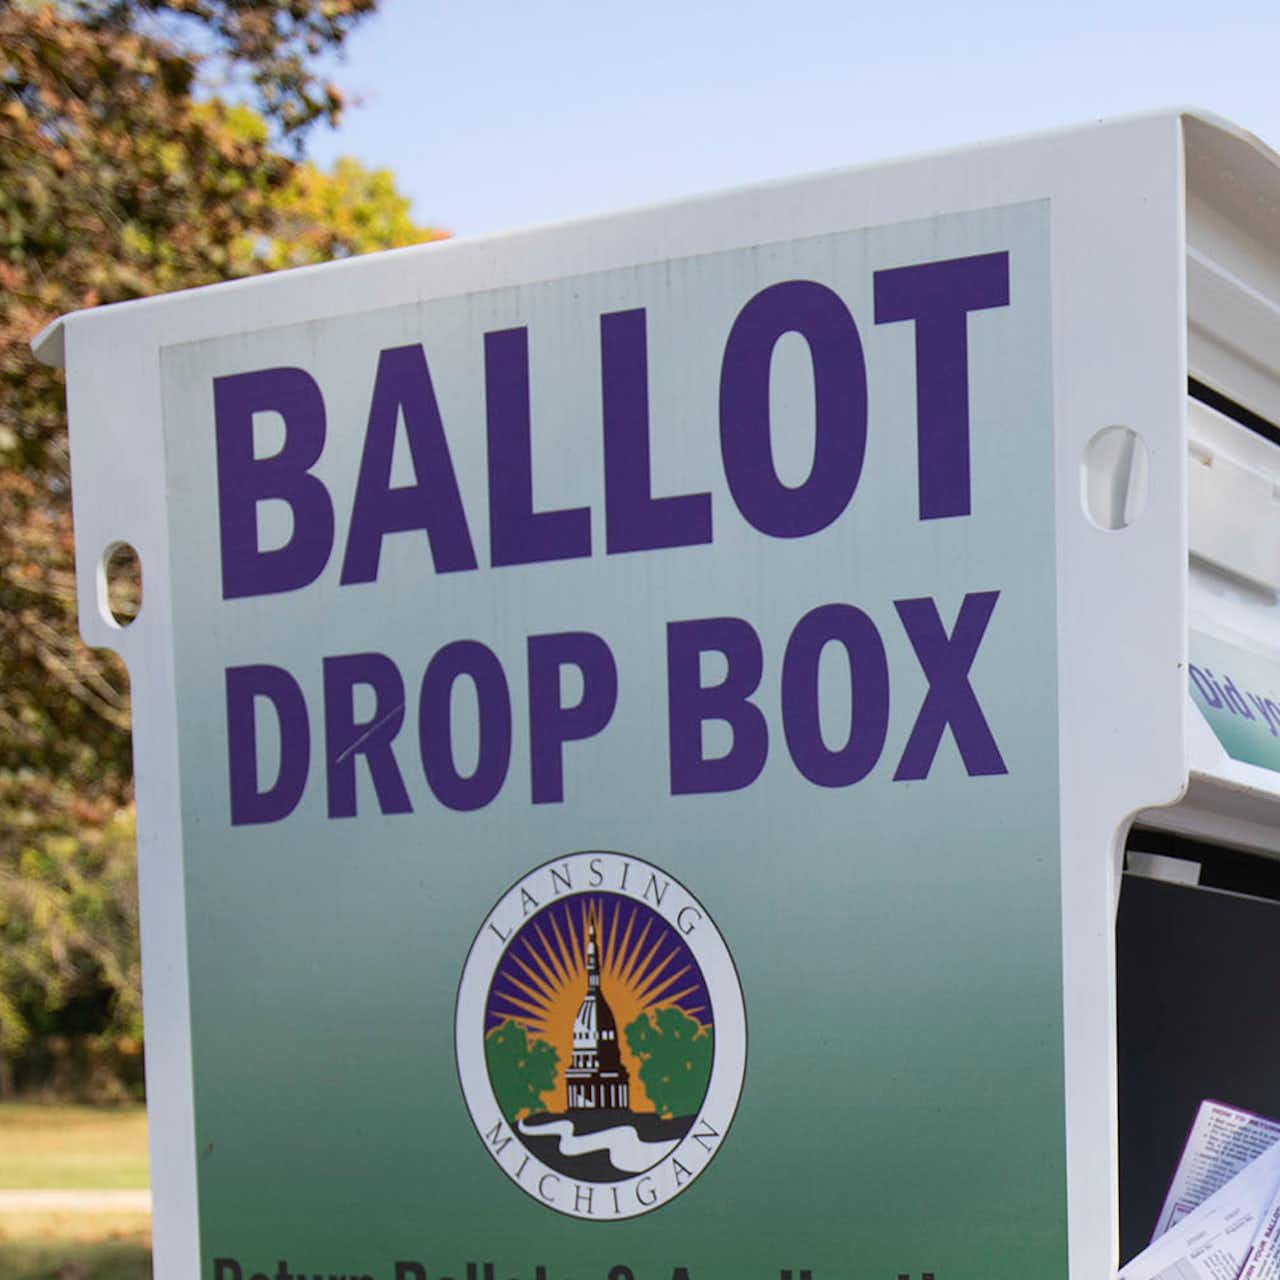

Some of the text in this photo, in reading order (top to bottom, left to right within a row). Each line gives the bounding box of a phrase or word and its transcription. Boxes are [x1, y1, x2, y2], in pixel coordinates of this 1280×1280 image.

[212, 250, 1010, 600] BALLOT
[225, 590, 1010, 827] DROP BOX
[1189, 664, 1255, 720] Did
[489, 858, 703, 944] LANSING
[486, 1120, 719, 1214] MICHIGAN
